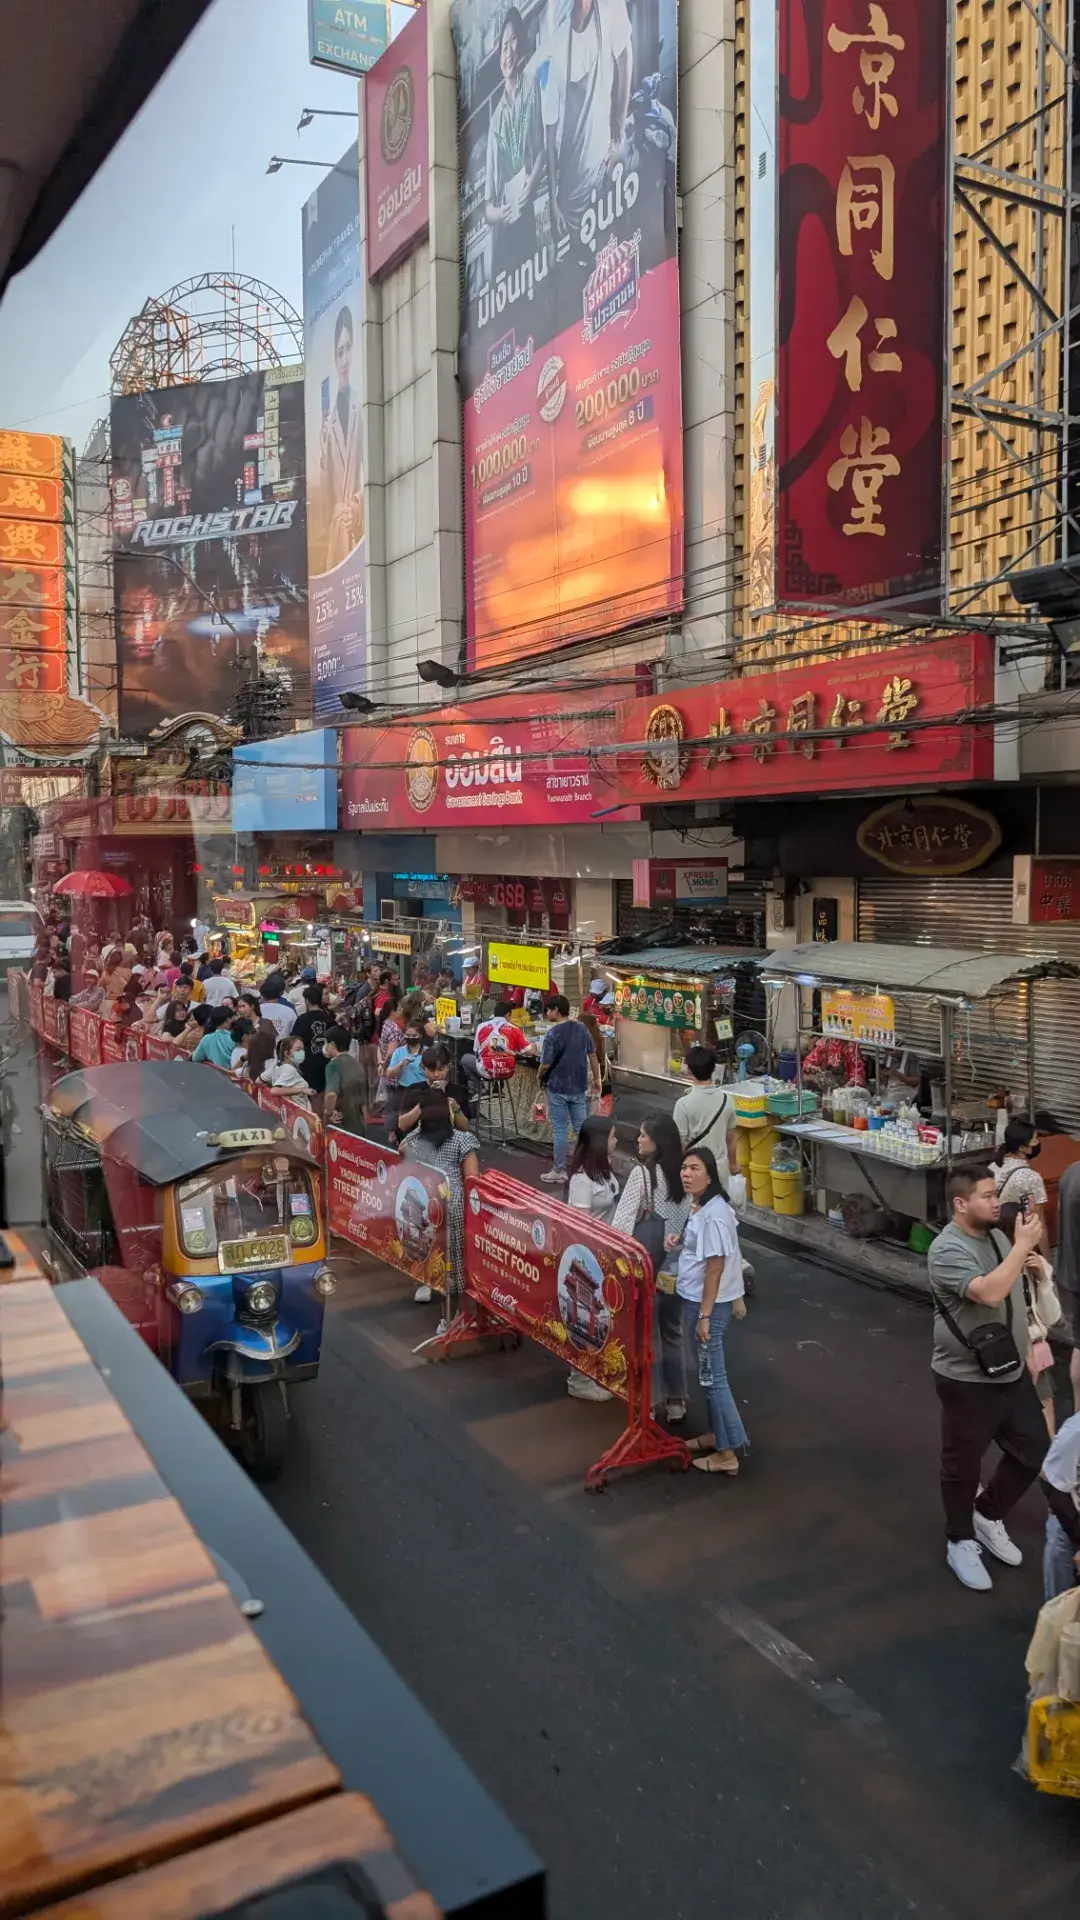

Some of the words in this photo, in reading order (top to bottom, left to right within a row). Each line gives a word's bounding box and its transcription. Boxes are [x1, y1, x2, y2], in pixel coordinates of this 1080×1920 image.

[334, 8, 367, 32] ATM
[317, 40, 379, 67] EXCHANG
[377, 163, 422, 228] ออมสิน
[477, 246, 549, 328] มีเงินทุน
[580, 162, 640, 252] อุ่นใจ
[826, 3, 906, 537] 京同仁堂
[588, 259, 632, 311] ธนาคาร
[575, 366, 640, 428] 200,000
[641, 368, 659, 388] บาท
[628, 409, 635, 426] 8
[636, 400, 644, 421] ปี
[470, 434, 528, 490] 1,000,000
[511, 473, 521, 488] 10
[521, 465, 528, 483] ปี
[131, 500, 298, 547] ROCKSTAR
[345, 584, 364, 611] 2.5%
[702, 676, 918, 770] 北京同仁堂
[445, 733, 466, 746] ธนาคาร
[445, 736, 523, 789] ออมสิน
[546, 774, 590, 789] สาขาเยาวราช
[348, 800, 390, 816] รัฐบาลเป็นประกัน
[445, 793, 482, 809] Government
[482, 791, 506, 808] Savings
[506, 790, 523, 805] Bank
[574, 792, 593, 802] Branch
[877, 823, 973, 851] 北京同仁堂
[682, 871, 715, 881] XPRESS
[692, 878, 720, 887] MONEY
[495, 883, 525, 909] GSB
[230, 1130, 267, 1142] TAXI
[340, 1166, 374, 1191] YAOWARAJ
[333, 1177, 359, 1200] STREET
[361, 1190, 383, 1212] FOOD
[484, 1221, 527, 1256] YAOWARAJ
[474, 1234, 509, 1266] STREET
[510, 1256, 540, 1283] FOOD
[490, 1285, 518, 1314] Coca-Cola
